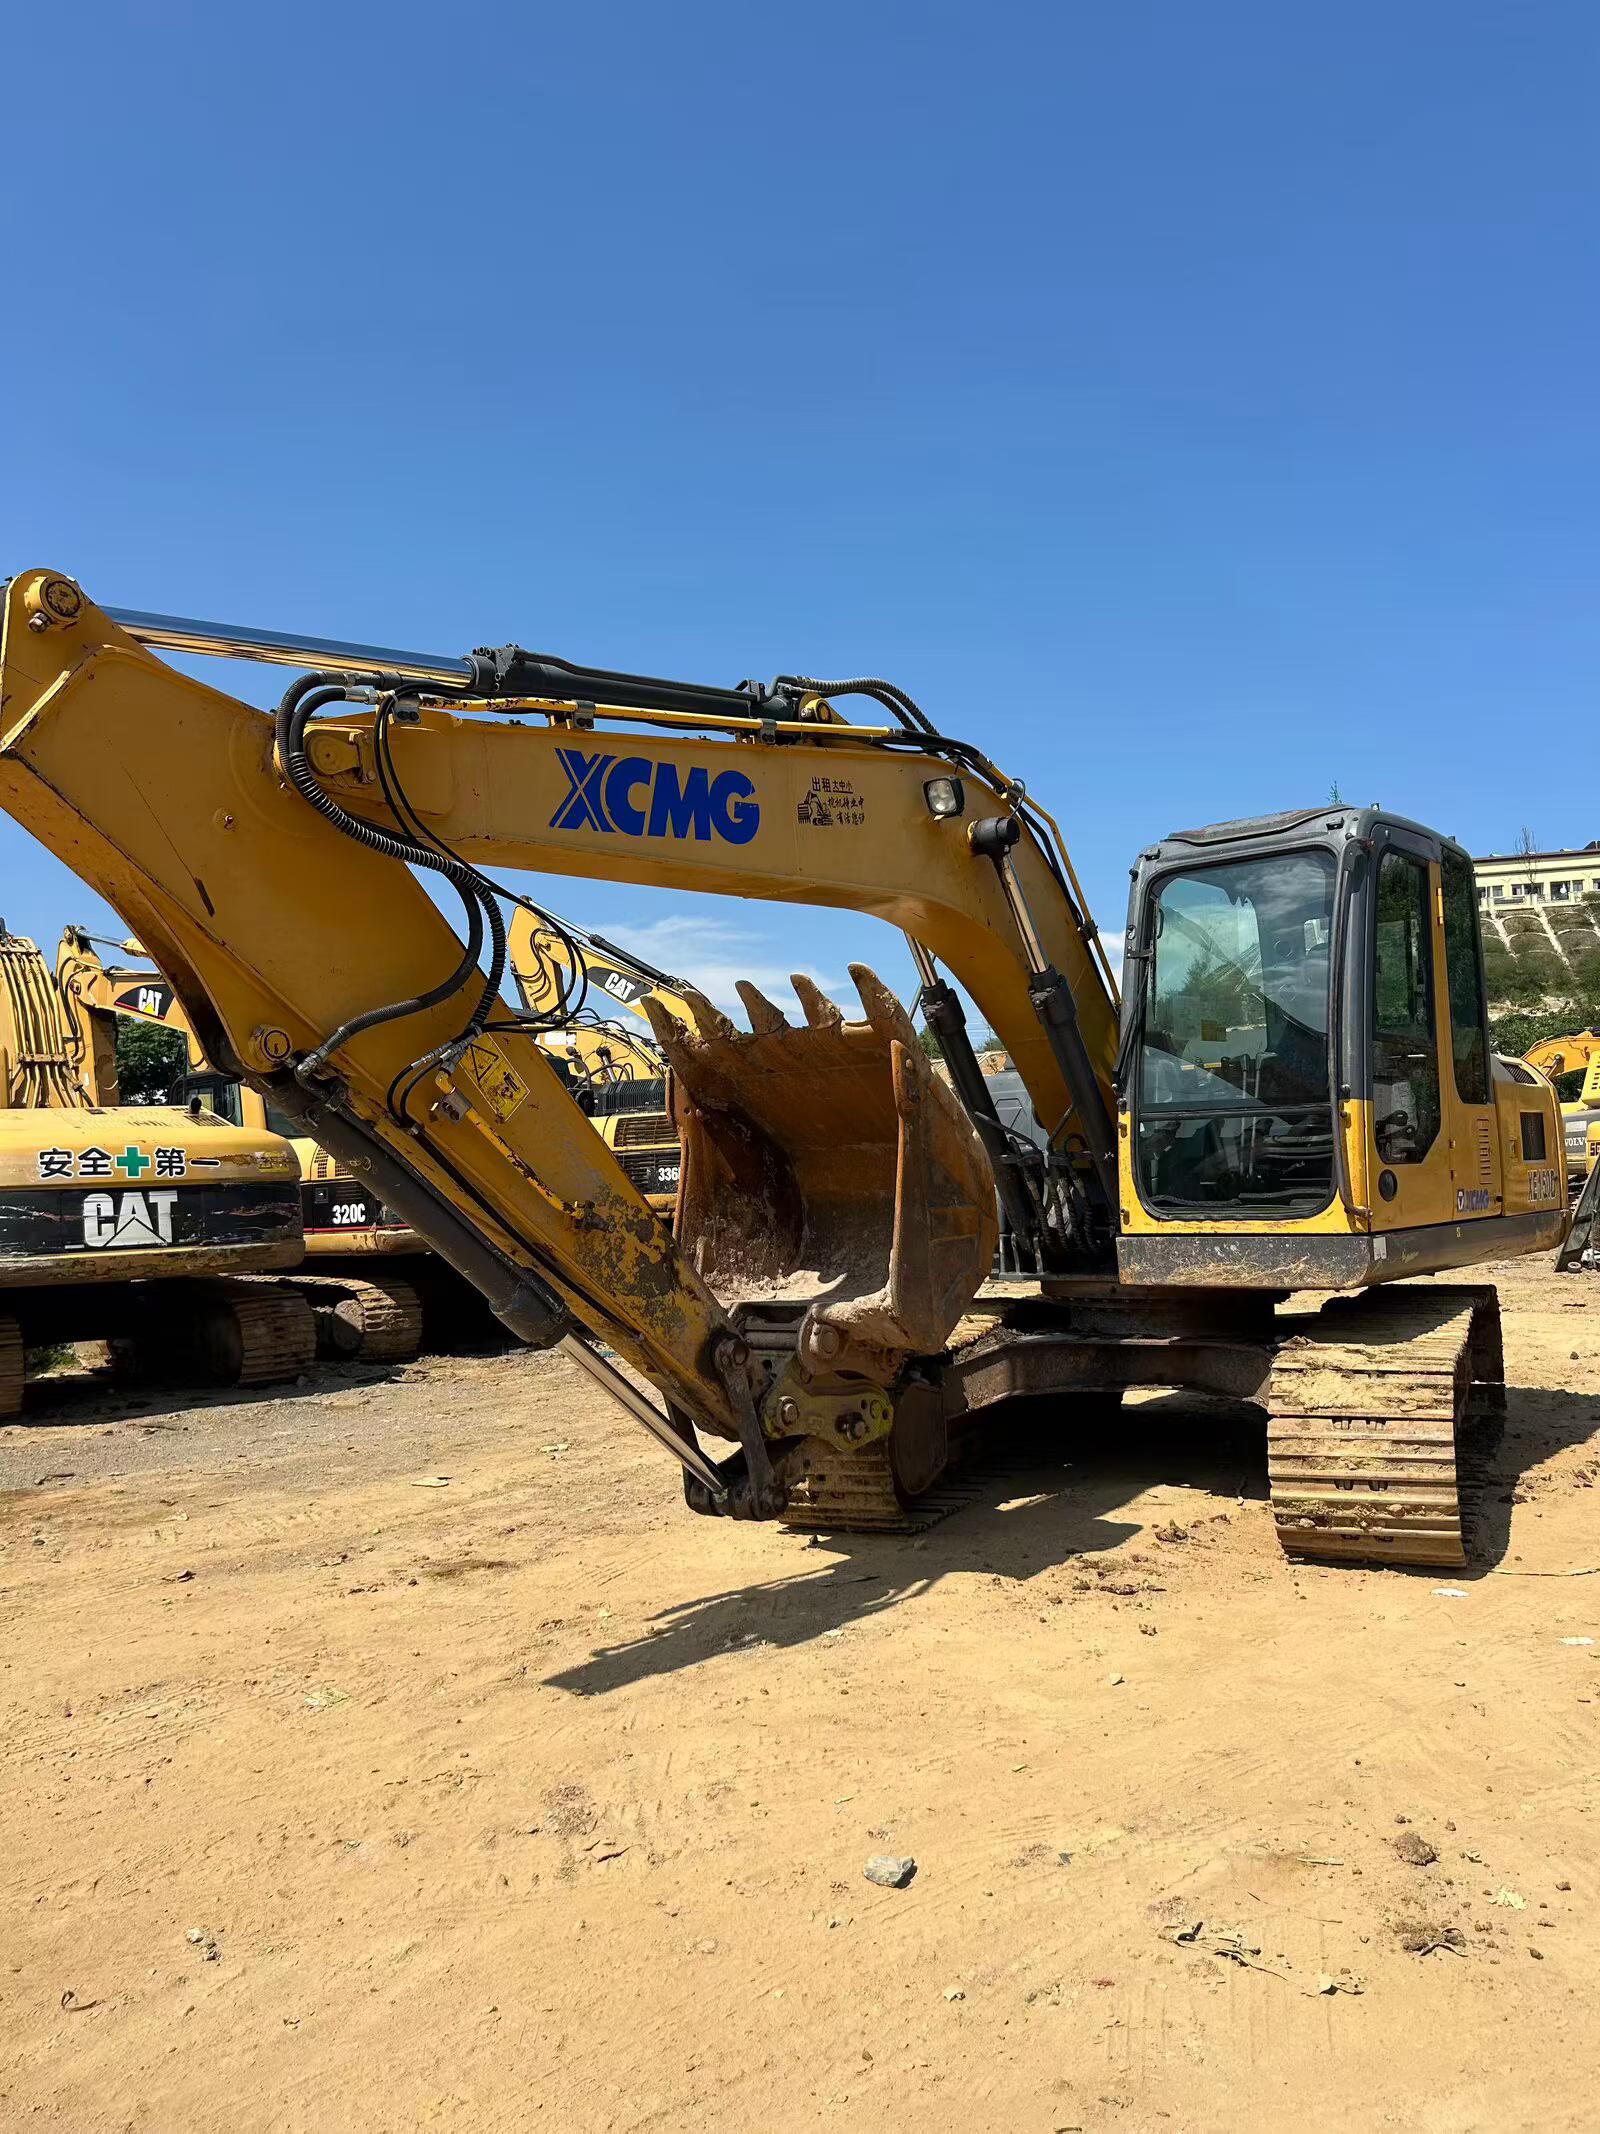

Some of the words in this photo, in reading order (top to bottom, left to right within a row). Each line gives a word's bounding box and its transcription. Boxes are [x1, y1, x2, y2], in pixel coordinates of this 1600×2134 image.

[548, 747, 761, 845] XCMG
[604, 972, 636, 1001] CAT
[138, 987, 163, 1017] CAT
[39, 1146, 113, 1179] 安全
[154, 1146, 220, 1179] 第一
[658, 1166, 681, 1182] 336
[83, 1190, 178, 1247] CAT
[332, 1202, 366, 1225] 320C
